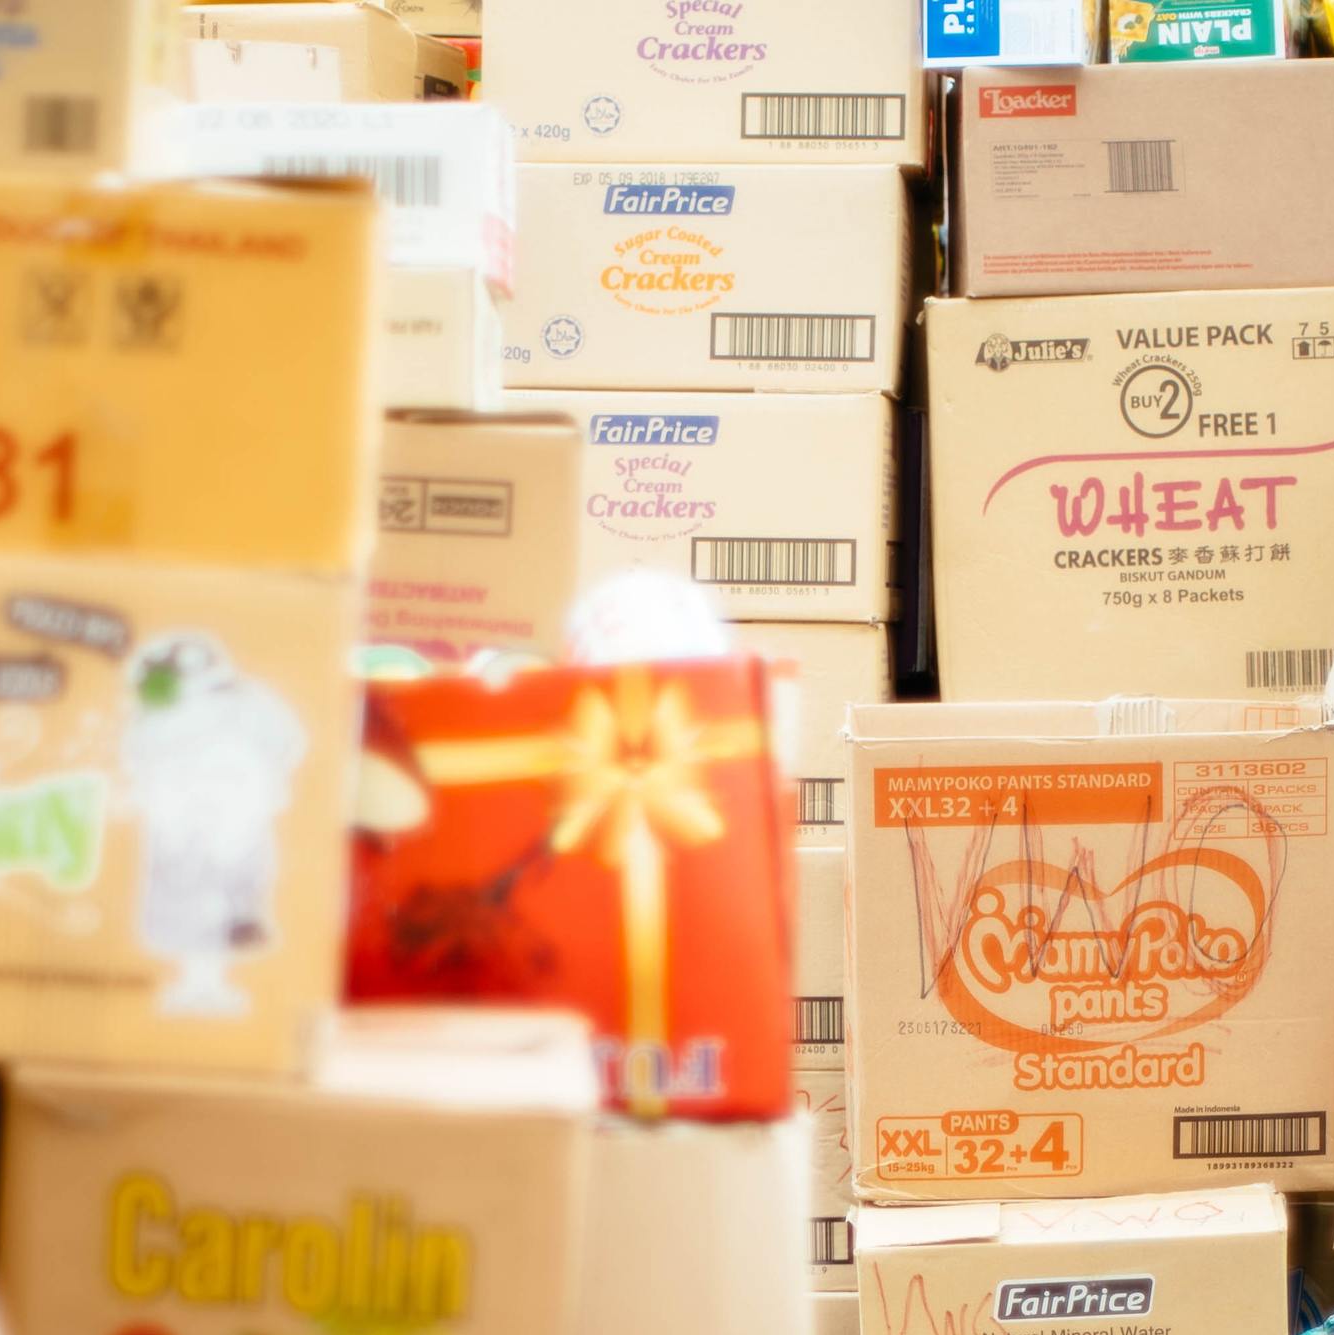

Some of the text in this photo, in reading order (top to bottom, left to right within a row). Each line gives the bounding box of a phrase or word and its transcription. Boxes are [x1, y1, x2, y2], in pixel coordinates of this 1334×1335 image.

[675, 20, 734, 36] Cream
[1158, 21, 1252, 45] PLAIN
[636, 37, 767, 62] Crackers
[983, 89, 1072, 115] Loacker
[573, 173, 592, 186] EXP
[598, 173, 612, 186] 05
[639, 173, 666, 185] 2018
[607, 187, 731, 214] FairPrice
[613, 226, 723, 259] Sugar Coated
[639, 250, 701, 266] Cream
[600, 266, 735, 292] Crackers
[1116, 323, 1274, 350] VALUE PACK
[1013, 340, 1084, 361] Julie's
[1112, 354, 1203, 397] Wheat Crackers 250g
[1131, 379, 1181, 420] BUY 2
[592, 416, 715, 444] FairPrice
[1198, 412, 1277, 437] FREE 1
[614, 453, 693, 478] Special
[623, 478, 683, 495] Cream
[586, 495, 716, 520] Crackers
[1050, 472, 1297, 537] WHEAT
[1054, 548, 1162, 569] CRACKERS
[1119, 569, 1226, 584] BISKUT GANDUM
[1102, 588, 1244, 608] 750g x 8 Packets
[1195, 761, 1307, 777] 3113602
[888, 772, 1152, 792] MAMYPOKO PANTS STANDARD
[967, 886, 1247, 994] MamyPoko
[1054, 983, 1164, 1023] pants
[1014, 1043, 1205, 1091] Standard
[1174, 1105, 1197, 1114] Made
[1207, 1104, 1241, 1114] Indonesia
[950, 1114, 1010, 1133] PANTS
[881, 1130, 942, 1158] XXL
[954, 1140, 1005, 1173] 32
[1030, 1121, 1069, 1171] 4
[106, 1172, 472, 1325] Carolin
[1005, 1285, 1145, 1316] FairPrice
